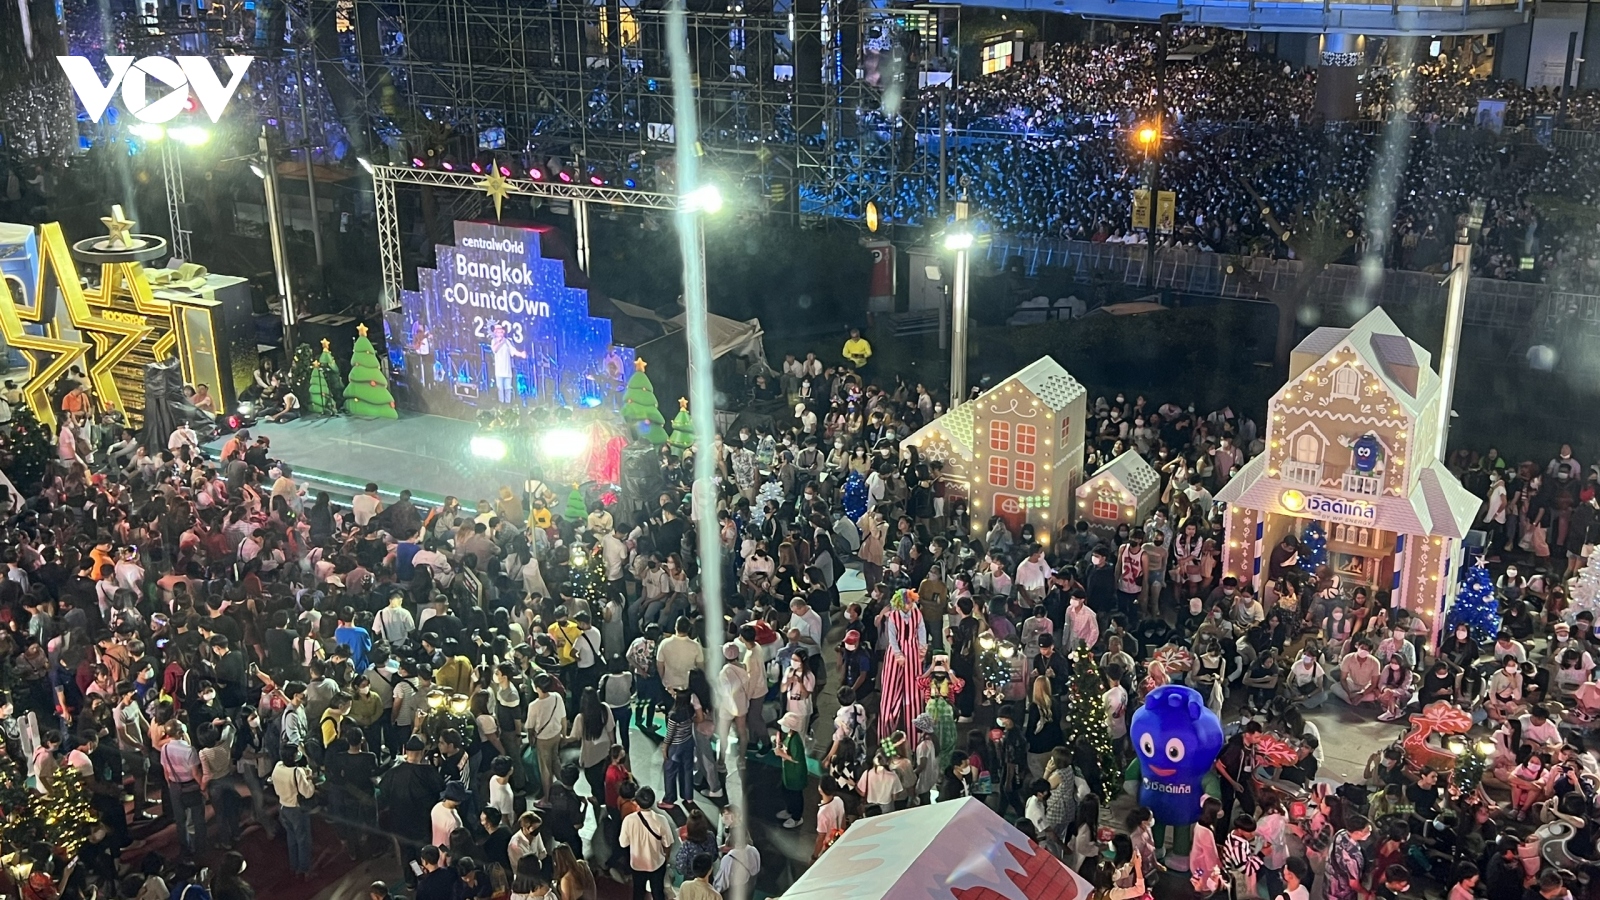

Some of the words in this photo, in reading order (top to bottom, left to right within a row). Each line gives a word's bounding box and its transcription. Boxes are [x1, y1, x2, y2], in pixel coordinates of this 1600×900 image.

[462, 237, 524, 254] centralwOrld
[456, 253, 533, 287] Bangkok
[445, 282, 549, 317] cOuntdOwn
[102, 310, 146, 326] ROCKSTAR
[1345, 517, 1372, 526] ENERGY
